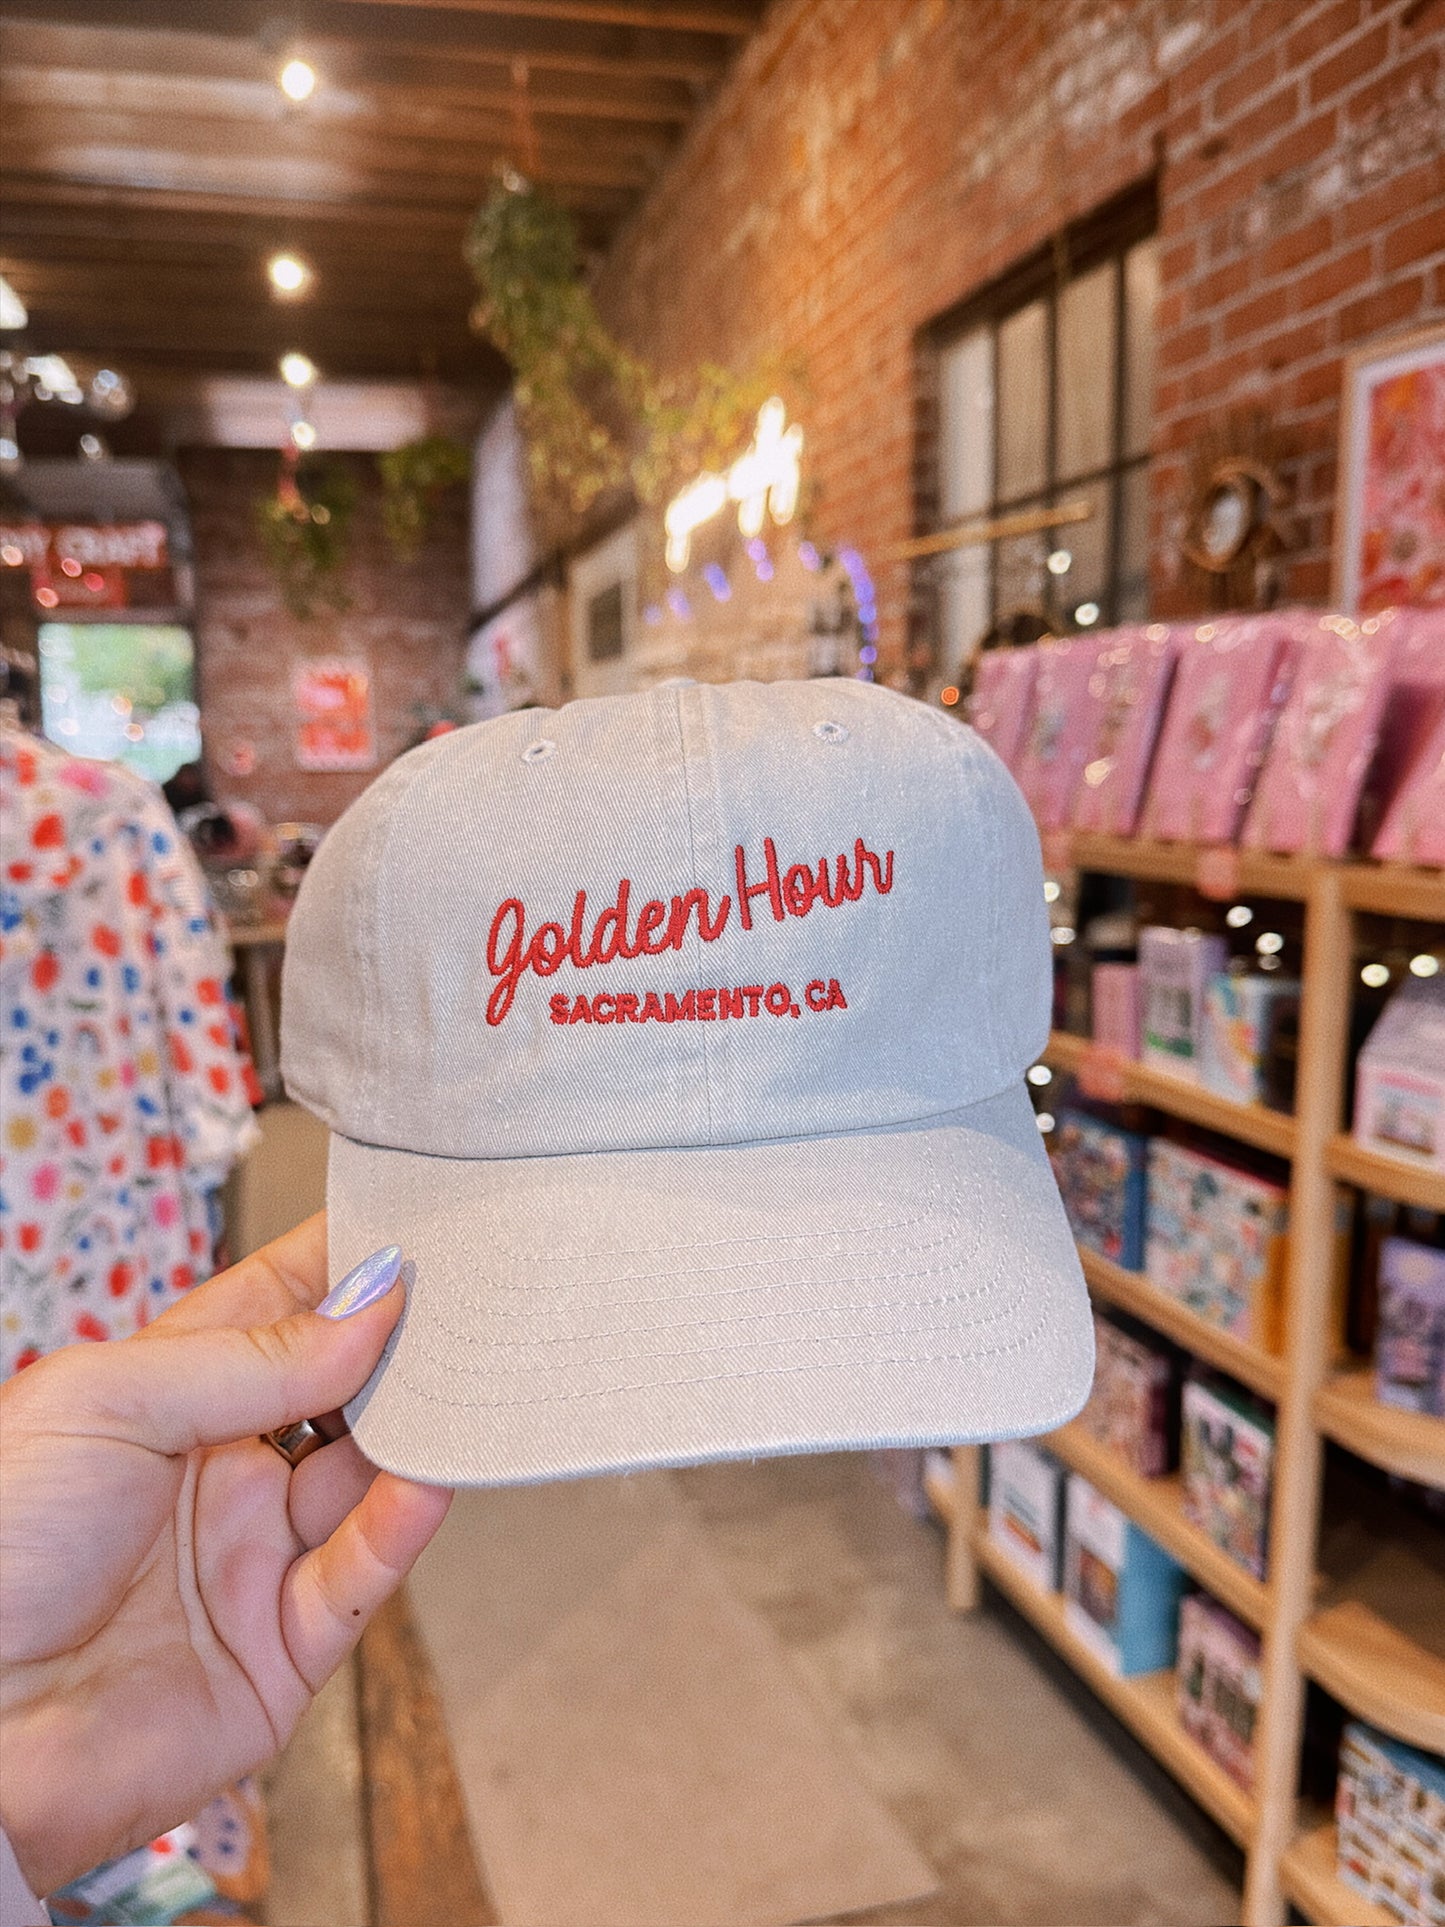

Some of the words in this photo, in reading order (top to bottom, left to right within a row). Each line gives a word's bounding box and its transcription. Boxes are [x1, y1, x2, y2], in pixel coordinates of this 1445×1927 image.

[486, 879, 731, 1026] Golden
[735, 837, 894, 930] Hour
[549, 983, 801, 1025] SACRAMENTO,
[805, 978, 848, 1013] CA
